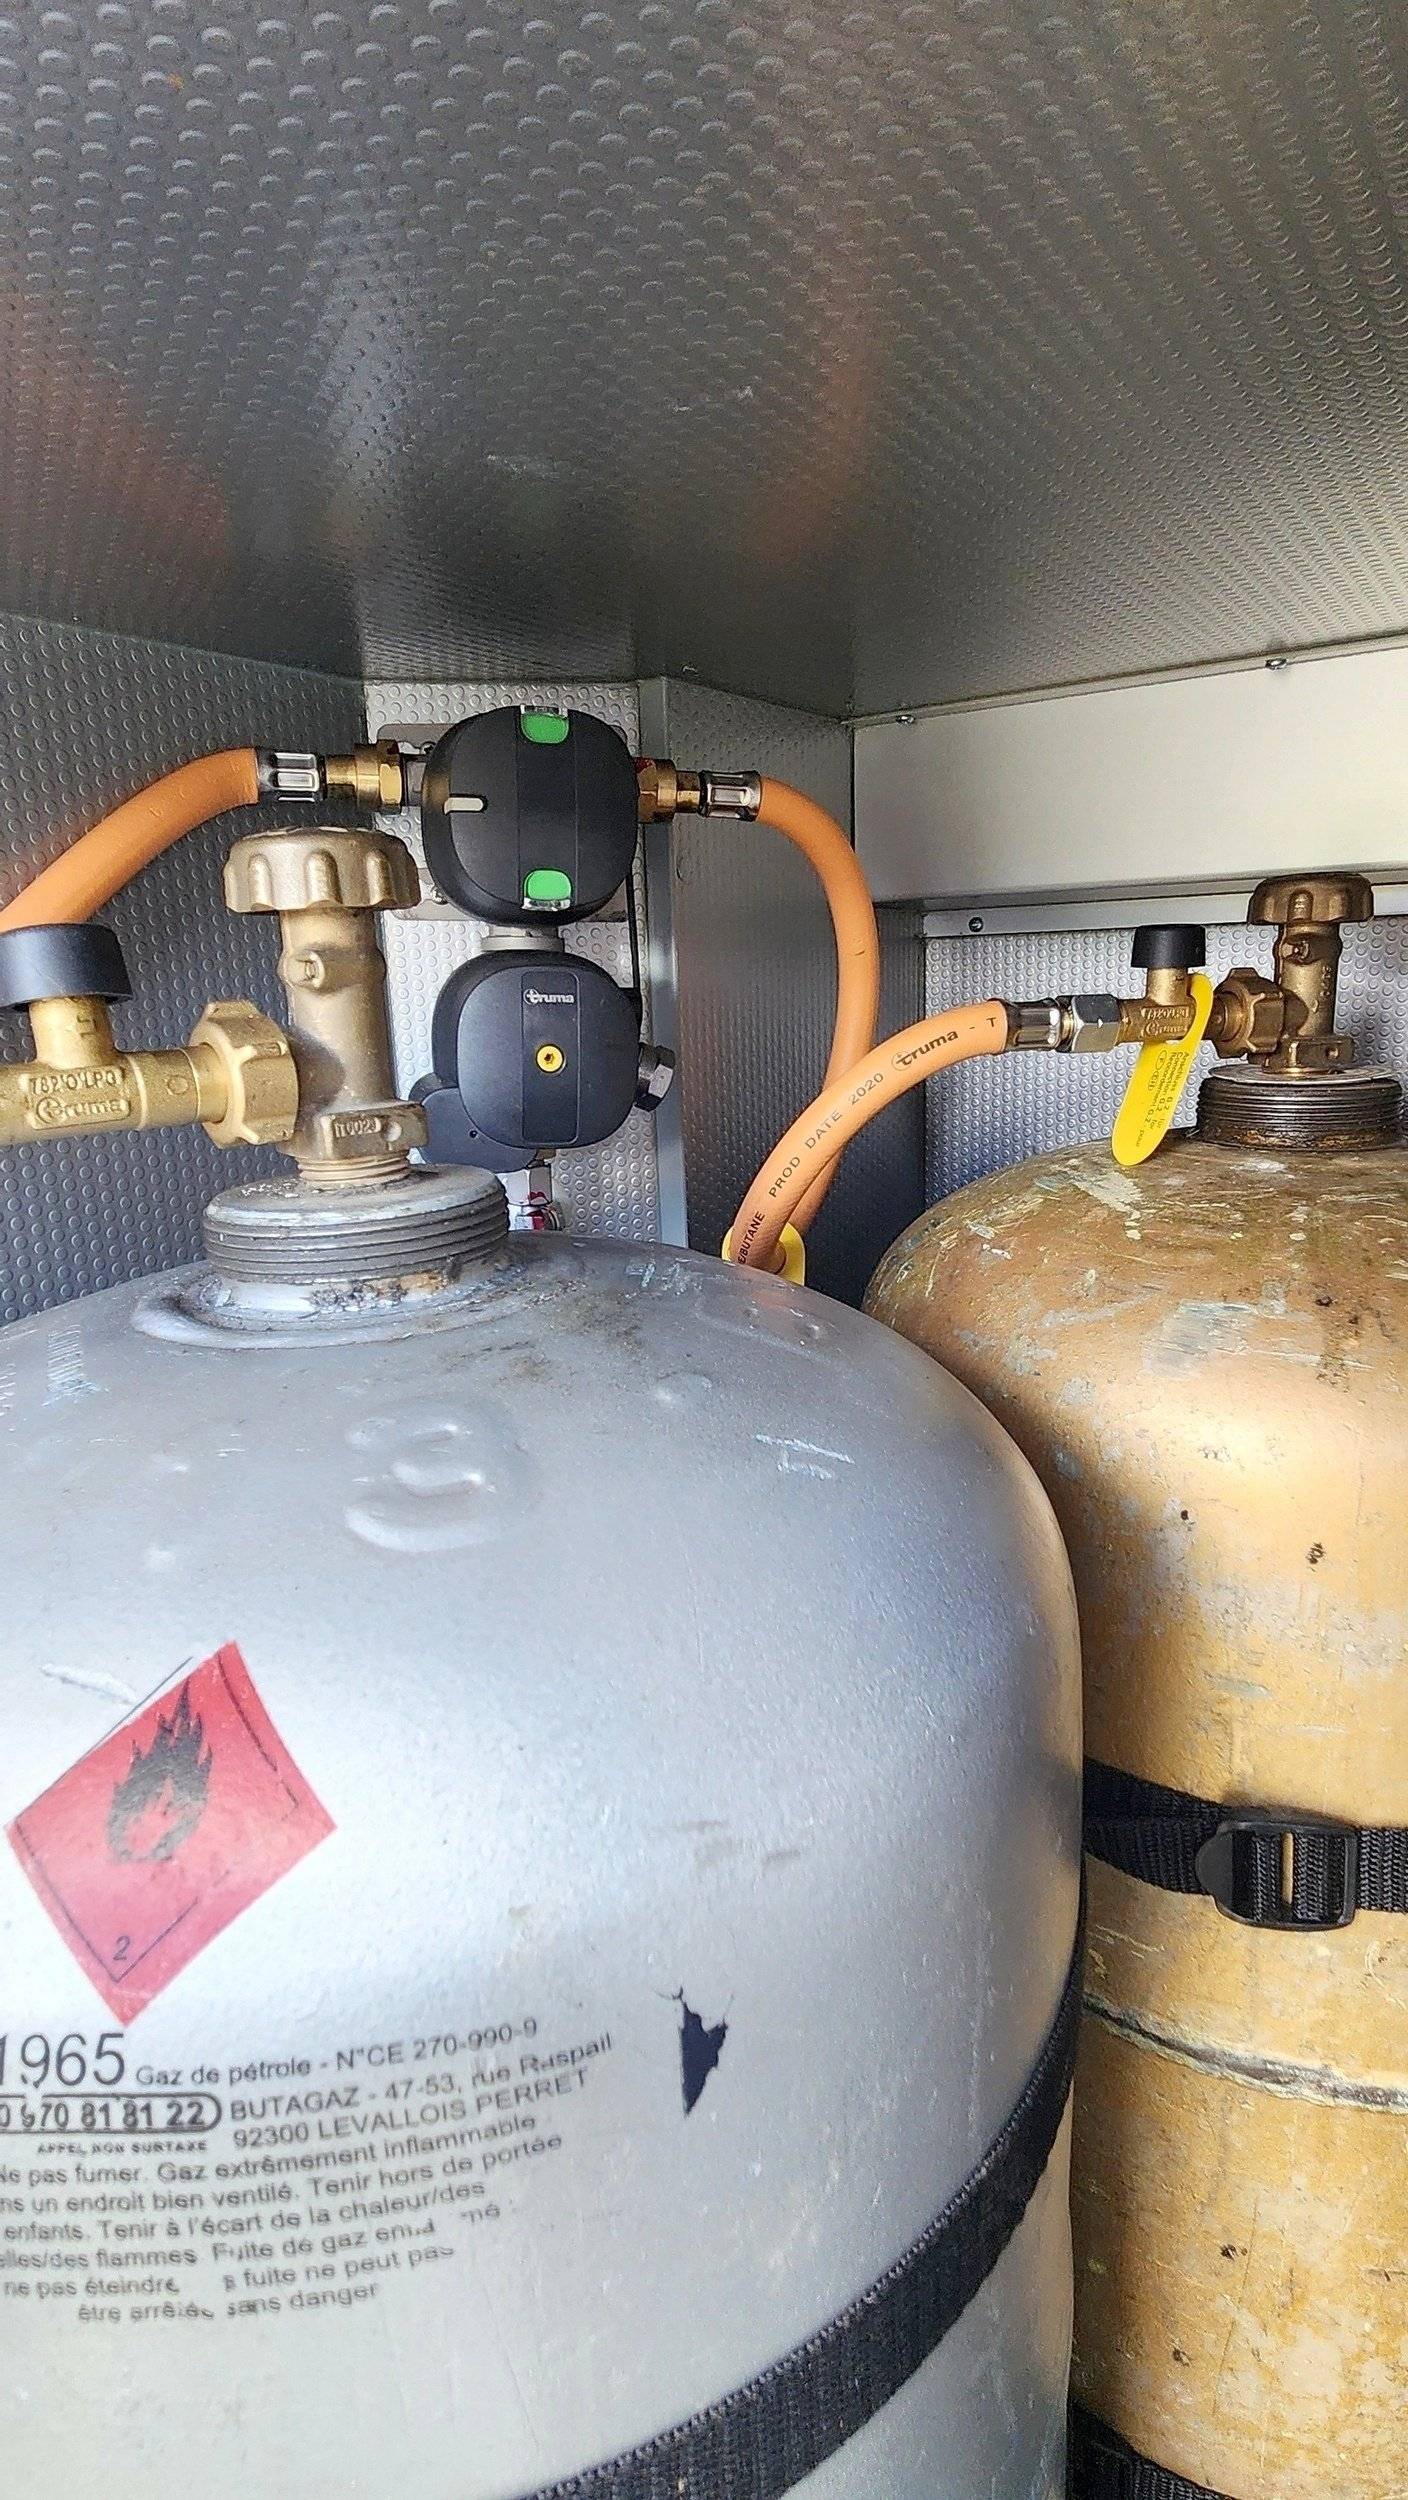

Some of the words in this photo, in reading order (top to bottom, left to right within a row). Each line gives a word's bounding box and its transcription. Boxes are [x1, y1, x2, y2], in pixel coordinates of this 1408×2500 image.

[523, 988, 575, 1005] truma
[768, 1156, 801, 1198] PROD
[804, 1110, 843, 1150] DATE
[848, 1072, 884, 1106] 2020
[891, 1030, 959, 1071] truma
[986, 1016, 998, 1028] T
[112, 1935, 130, 1961] 2
[136, 2065, 183, 2087] Gaz
[191, 2063, 220, 2085] de
[229, 2056, 311, 2087] pétrole
[412, 2015, 538, 2061] 270-990-9
[230, 2086, 360, 2121] BUTAGAZ
[471, 2065, 511, 2089] rue
[520, 2031, 612, 2076] Raspail
[167, 2100, 205, 2127] 22
[233, 2122, 309, 2149] 92300
[317, 2099, 467, 2140] LEVALLOIS
[476, 2066, 588, 2115] PERRET
[29, 2168, 68, 2187] pas
[157, 2161, 209, 2184] Gaz
[215, 2142, 377, 2179] extrêmement
[383, 2113, 536, 2160] inflammable
[31, 2197, 58, 2213] un
[66, 2191, 145, 2212] endroit
[153, 2190, 204, 2211] bien
[309, 2172, 372, 2197] Tenir
[379, 2163, 434, 2188] hors
[442, 2157, 473, 2178] de
[481, 2134, 562, 2174] portée
[98, 2218, 157, 2240] Tenir
[271, 2209, 302, 2231] de
[309, 2204, 331, 2226] la
[321, 2228, 366, 2255] gaz
[5, 2281, 31, 2297] ne
[37, 2281, 77, 2299] pas
[243, 2267, 297, 2288] fuite
[305, 2261, 335, 2281] ne
[344, 2250, 400, 2279] peut
[78, 2304, 122, 2323] être
[290, 2281, 379, 2310] danger
